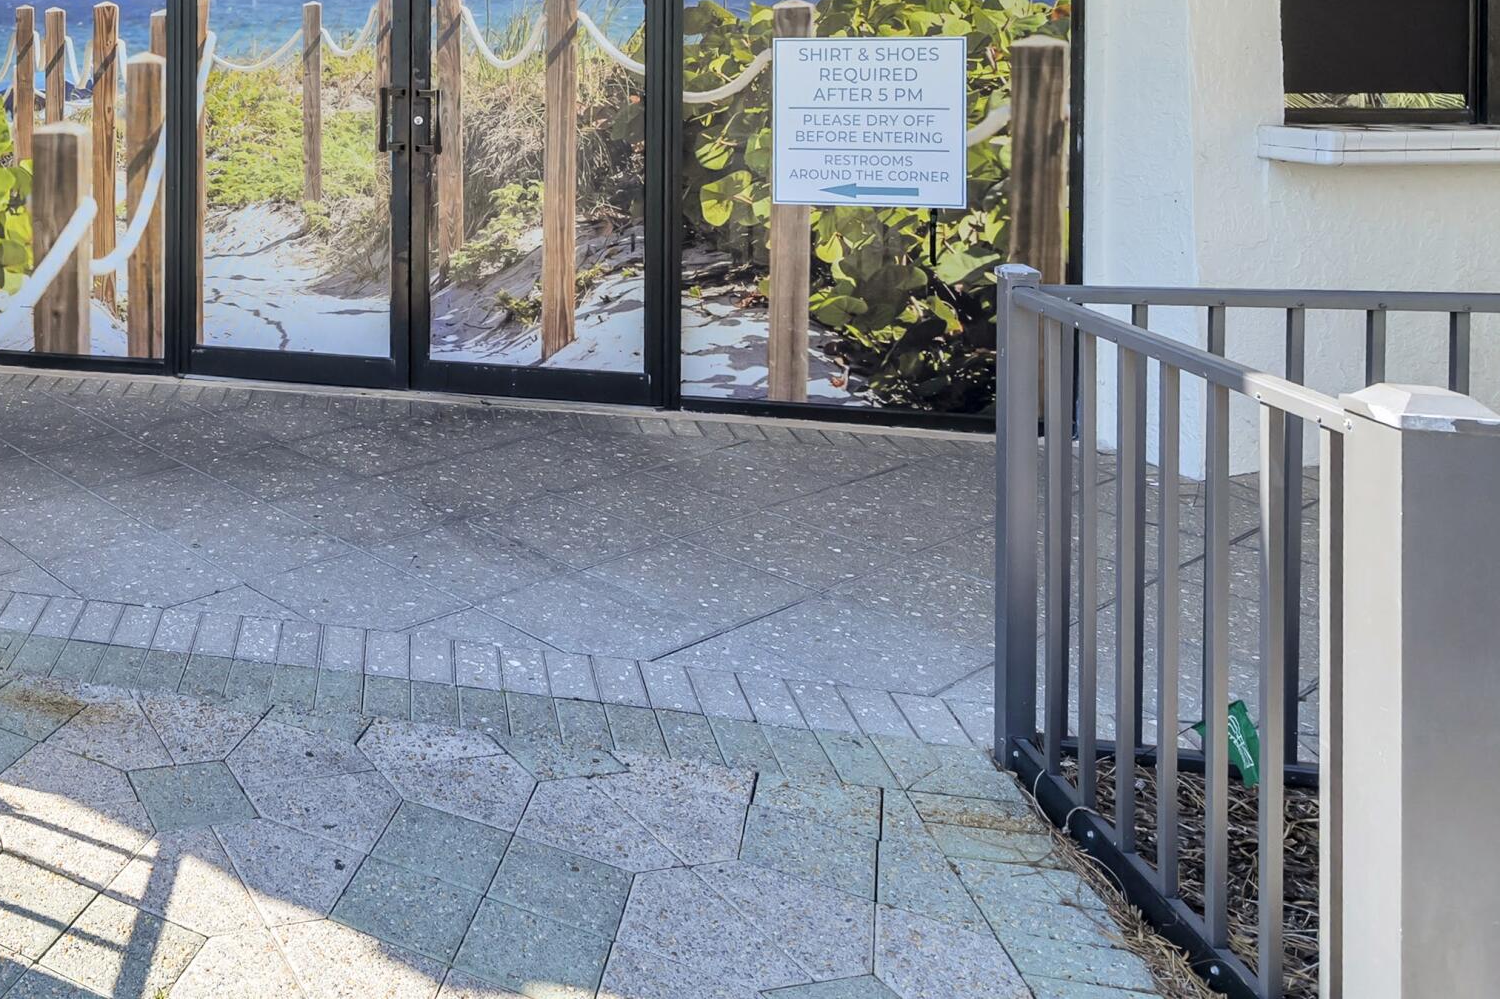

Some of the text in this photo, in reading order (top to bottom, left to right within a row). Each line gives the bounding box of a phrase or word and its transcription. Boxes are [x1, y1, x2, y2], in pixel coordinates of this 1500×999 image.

[799, 47, 939, 61] SHIRT & SHOES
[819, 67, 918, 84] REQUIRED
[813, 88, 923, 101] AFTER 5 PM
[803, 114, 936, 127] PLEASE DRY OFF
[795, 131, 943, 144] BEFORE ENTERING
[824, 154, 913, 166] RESTROOMS
[789, 169, 949, 182] AROUND THE CORNER
